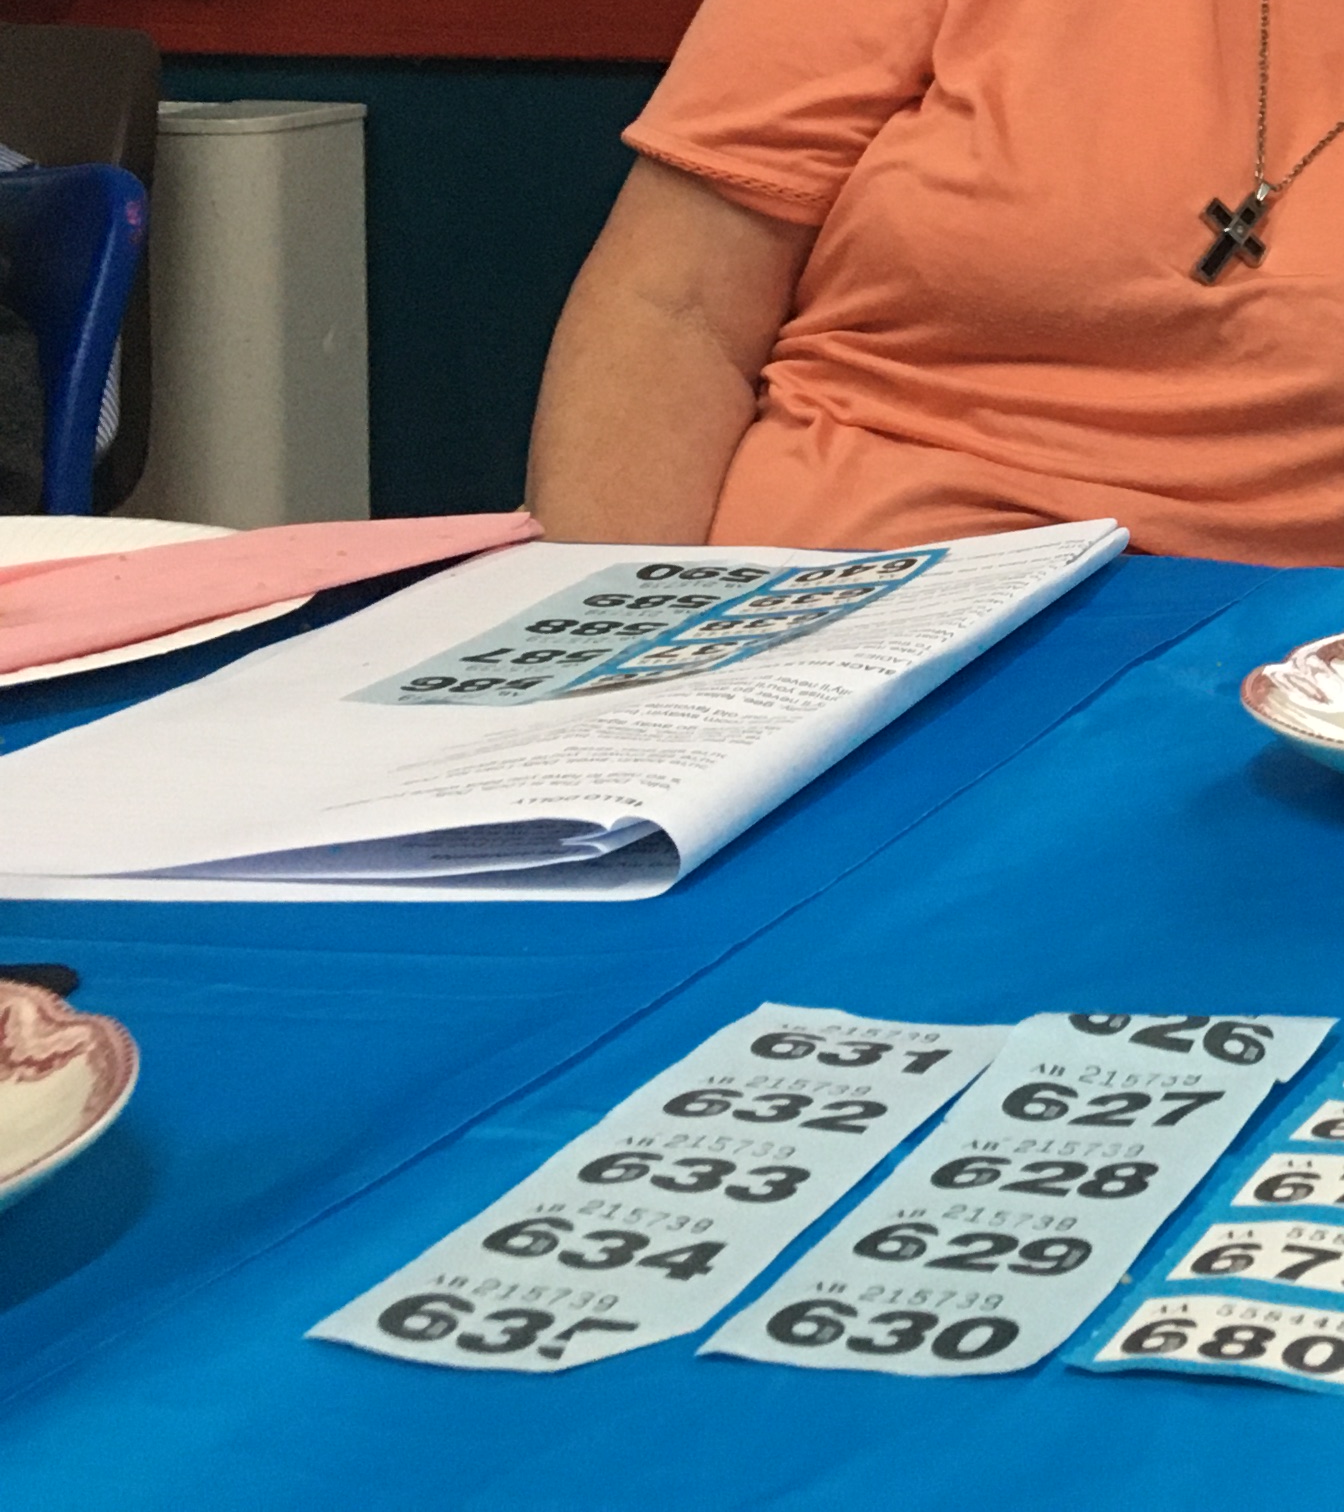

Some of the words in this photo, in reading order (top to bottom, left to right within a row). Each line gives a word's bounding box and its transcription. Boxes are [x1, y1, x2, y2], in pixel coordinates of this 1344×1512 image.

[636, 564, 770, 583] 590
[795, 558, 918, 582] 640
[583, 594, 720, 609] 589
[748, 587, 876, 607] 639
[525, 619, 669, 636] 588
[459, 648, 613, 665] 587
[841, 661, 897, 676] BLACK
[400, 675, 555, 693] 586
[750, 1031, 953, 1075] 631
[1068, 1013, 1274, 1066] 626
[662, 1088, 888, 1134] 632
[1001, 1081, 1225, 1127] 627
[577, 1151, 811, 1203] 633
[929, 1155, 1160, 1199] 628
[481, 1217, 727, 1281] 634
[852, 1222, 1093, 1276] 629
[766, 1298, 1020, 1361] 630
